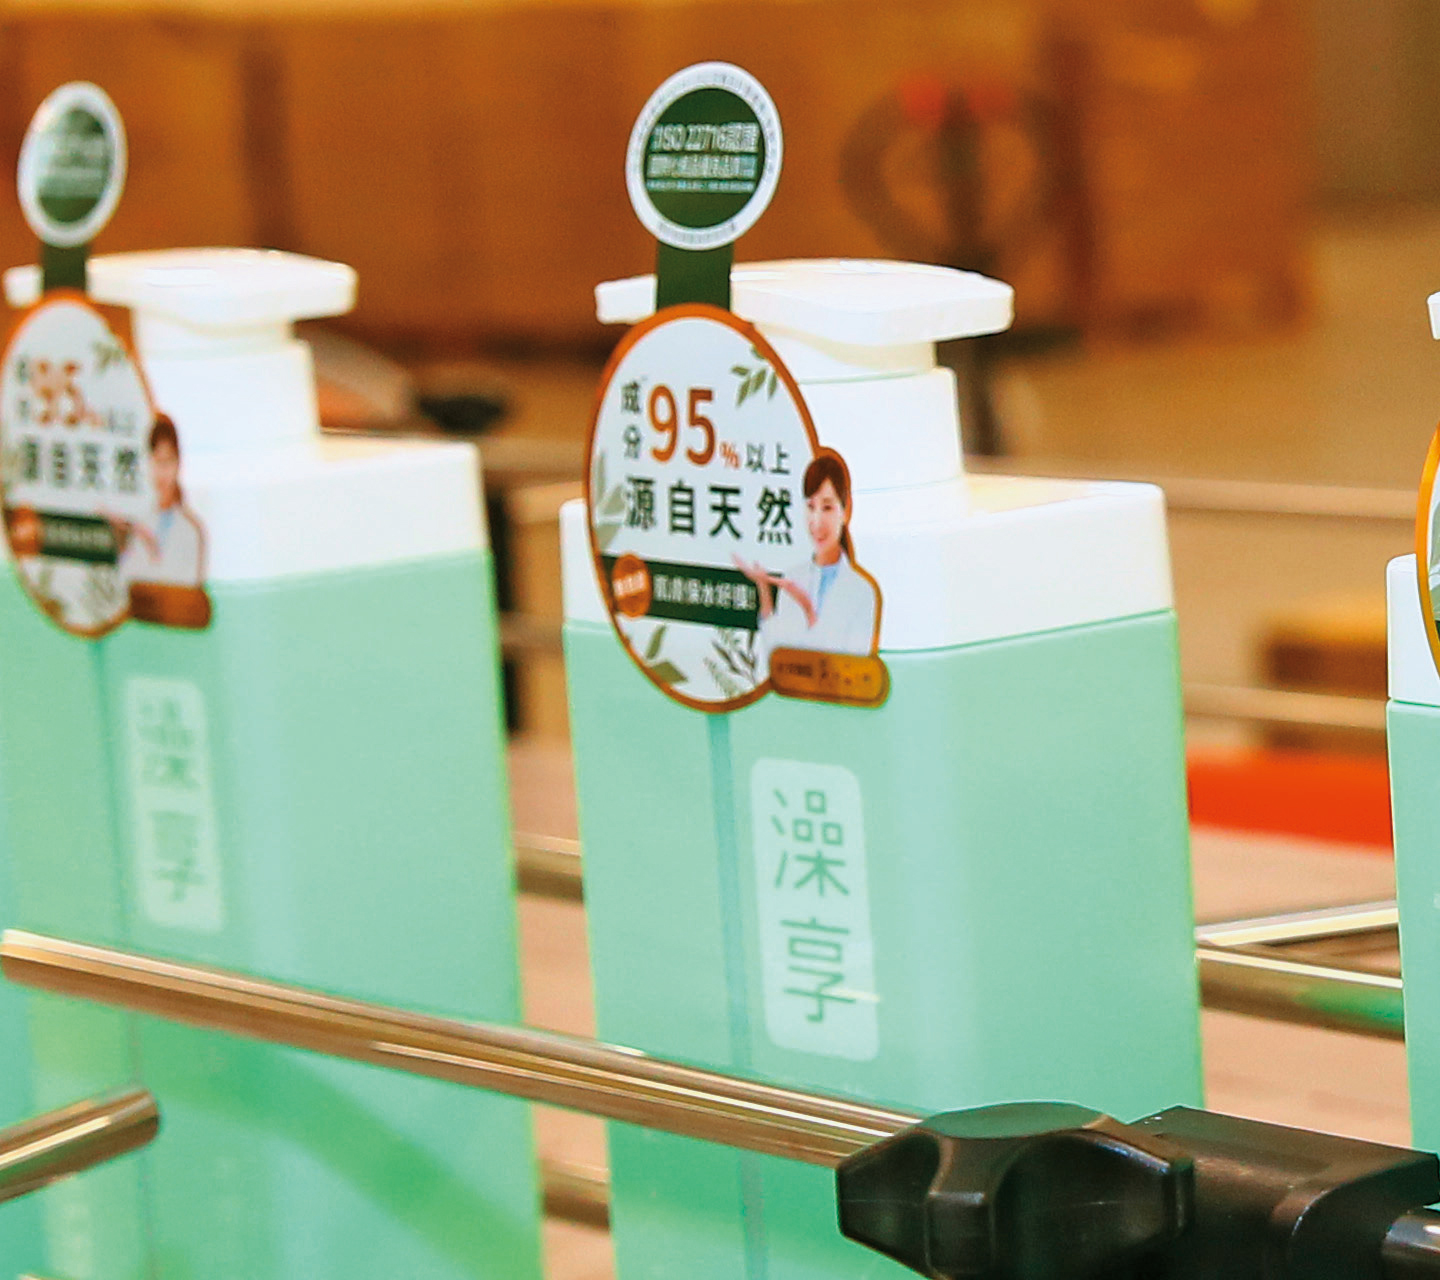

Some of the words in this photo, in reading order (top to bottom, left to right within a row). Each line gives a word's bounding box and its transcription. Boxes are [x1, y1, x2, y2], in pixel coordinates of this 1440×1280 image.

[626, 477, 792, 545] 源自天然
[770, 788, 856, 1024] 澡享
